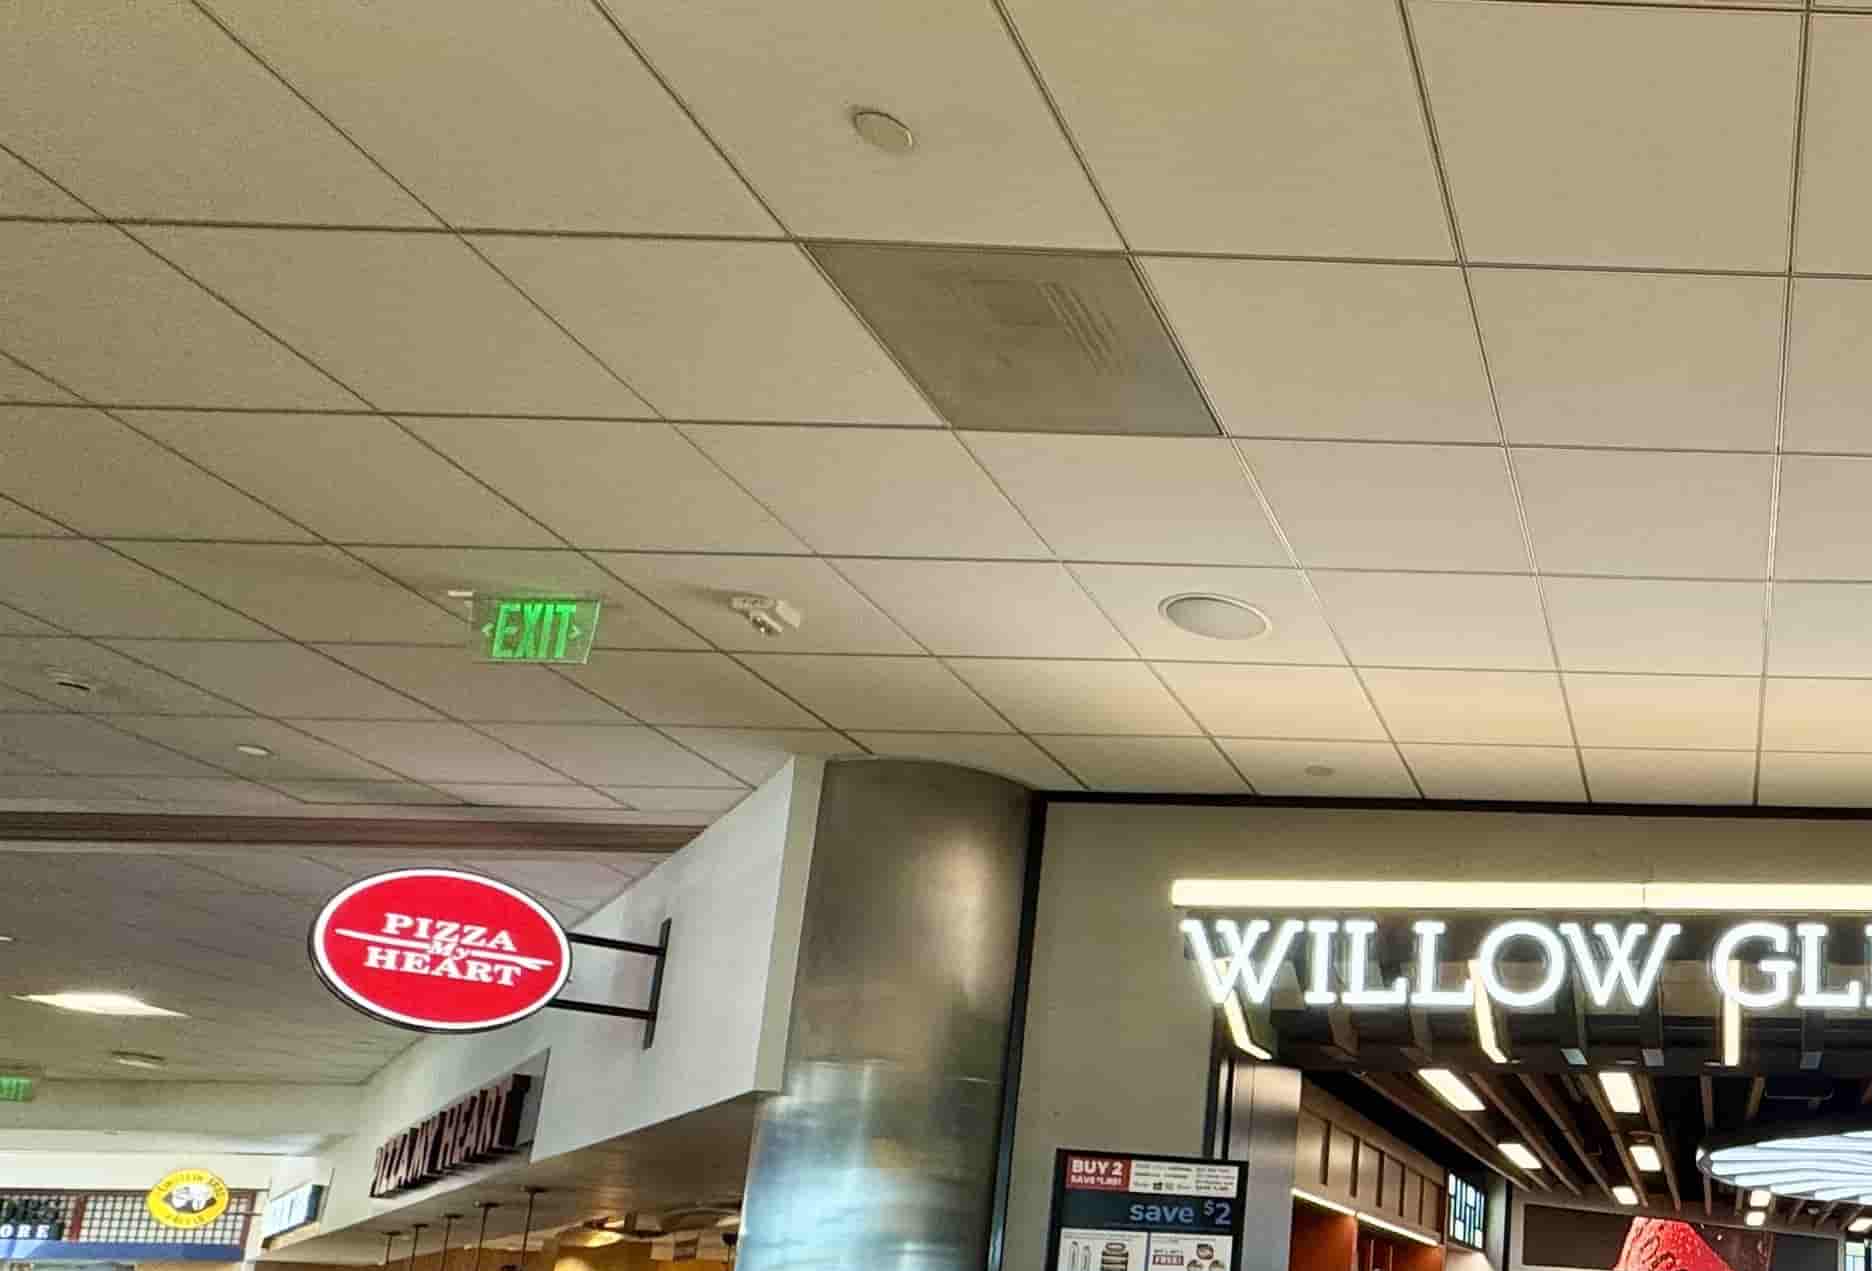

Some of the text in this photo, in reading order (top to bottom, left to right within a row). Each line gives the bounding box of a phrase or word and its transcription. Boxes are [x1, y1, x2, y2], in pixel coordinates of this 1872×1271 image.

[492, 603, 577, 658] EXIT
[381, 912, 518, 952] PIZZA
[429, 940, 471, 961] My
[363, 946, 522, 987] HEART
[1180, 918, 1682, 1007] WILLOW
[1071, 1159, 1123, 1176] BUY 2
[1129, 1199, 1232, 1225] save $2
